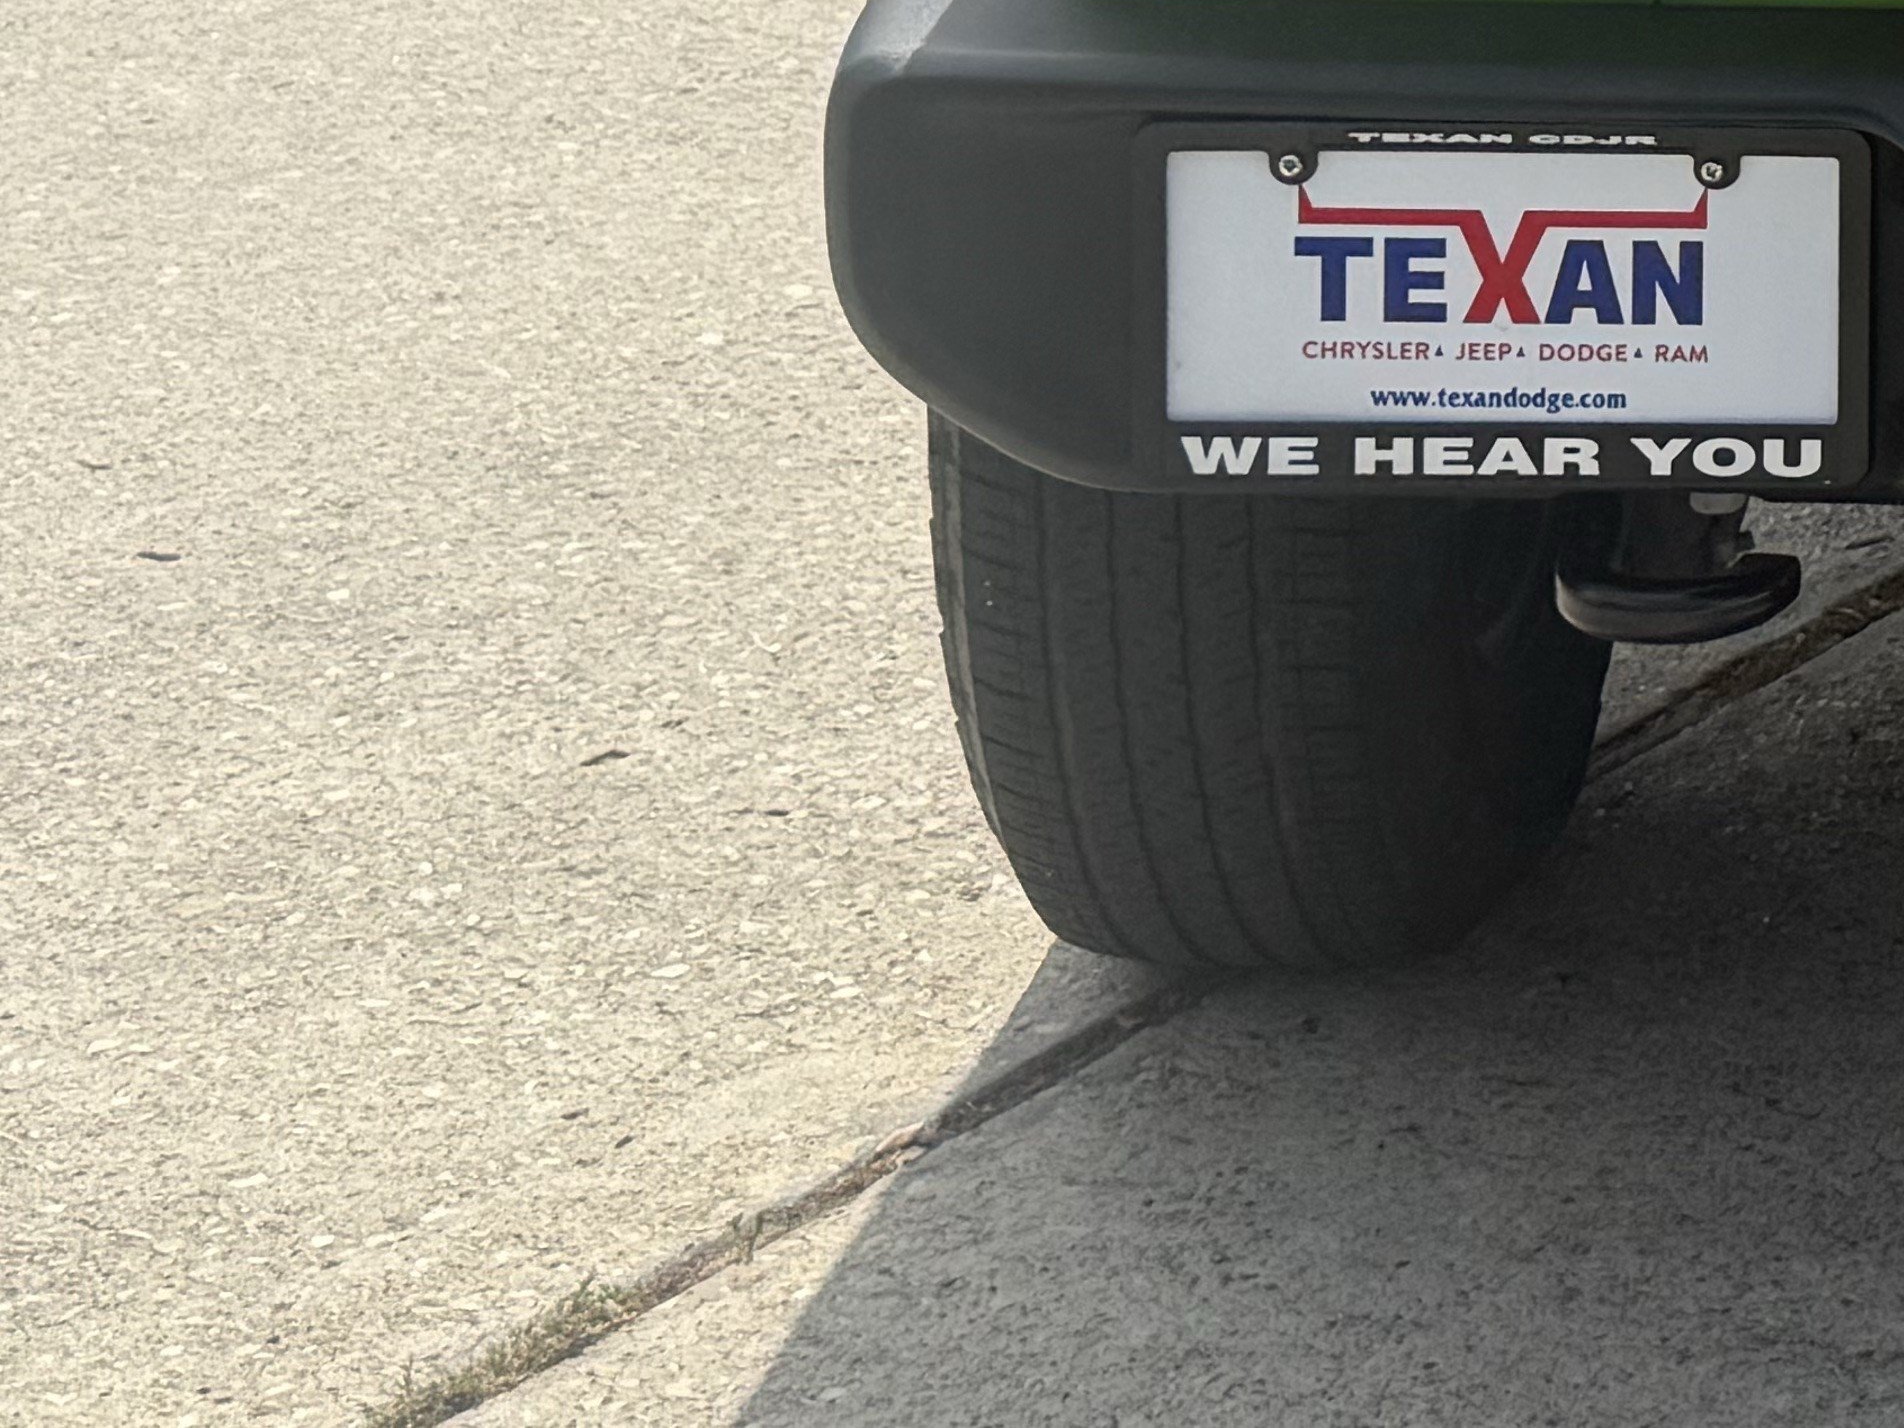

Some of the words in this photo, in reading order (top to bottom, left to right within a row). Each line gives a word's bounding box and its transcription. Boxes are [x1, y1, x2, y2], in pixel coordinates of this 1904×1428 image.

[1347, 132, 1513, 145] TEXAN
[1293, 209, 1706, 325] TEXAN
[1302, 340, 1429, 361] CHRYSLER
[1455, 342, 1510, 361] JEEP
[1538, 343, 1628, 363] DODGE
[1654, 344, 1709, 363] RAM
[1370, 387, 1627, 414] www.texandodge.com
[1180, 436, 1320, 475] WE
[1354, 437, 1600, 475] HEAR
[1631, 438, 1823, 477] YOU
